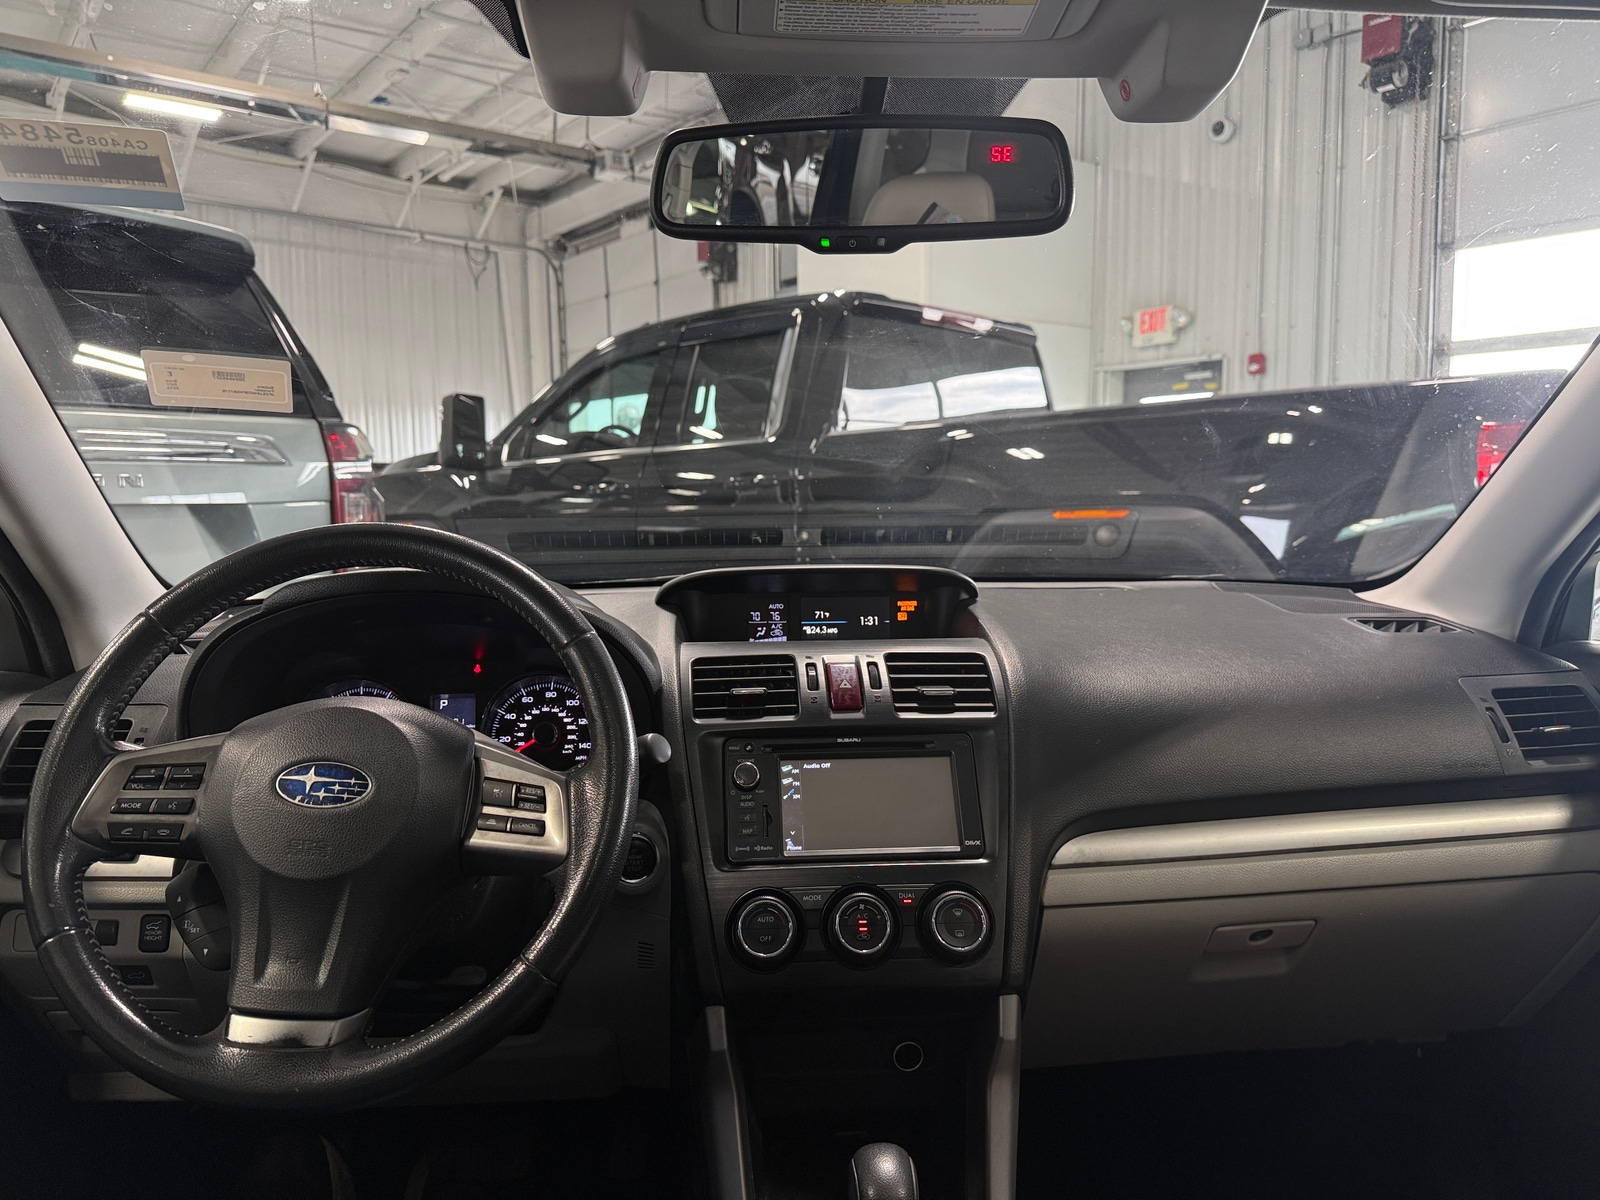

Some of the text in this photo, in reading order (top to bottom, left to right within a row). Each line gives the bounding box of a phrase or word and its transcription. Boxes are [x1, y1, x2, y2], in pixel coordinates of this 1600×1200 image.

[990, 145, 1012, 162] SE
[1139, 306, 1167, 335] EXIT
[859, 616, 878, 626] 1:31
[440, 700, 448, 710] P
